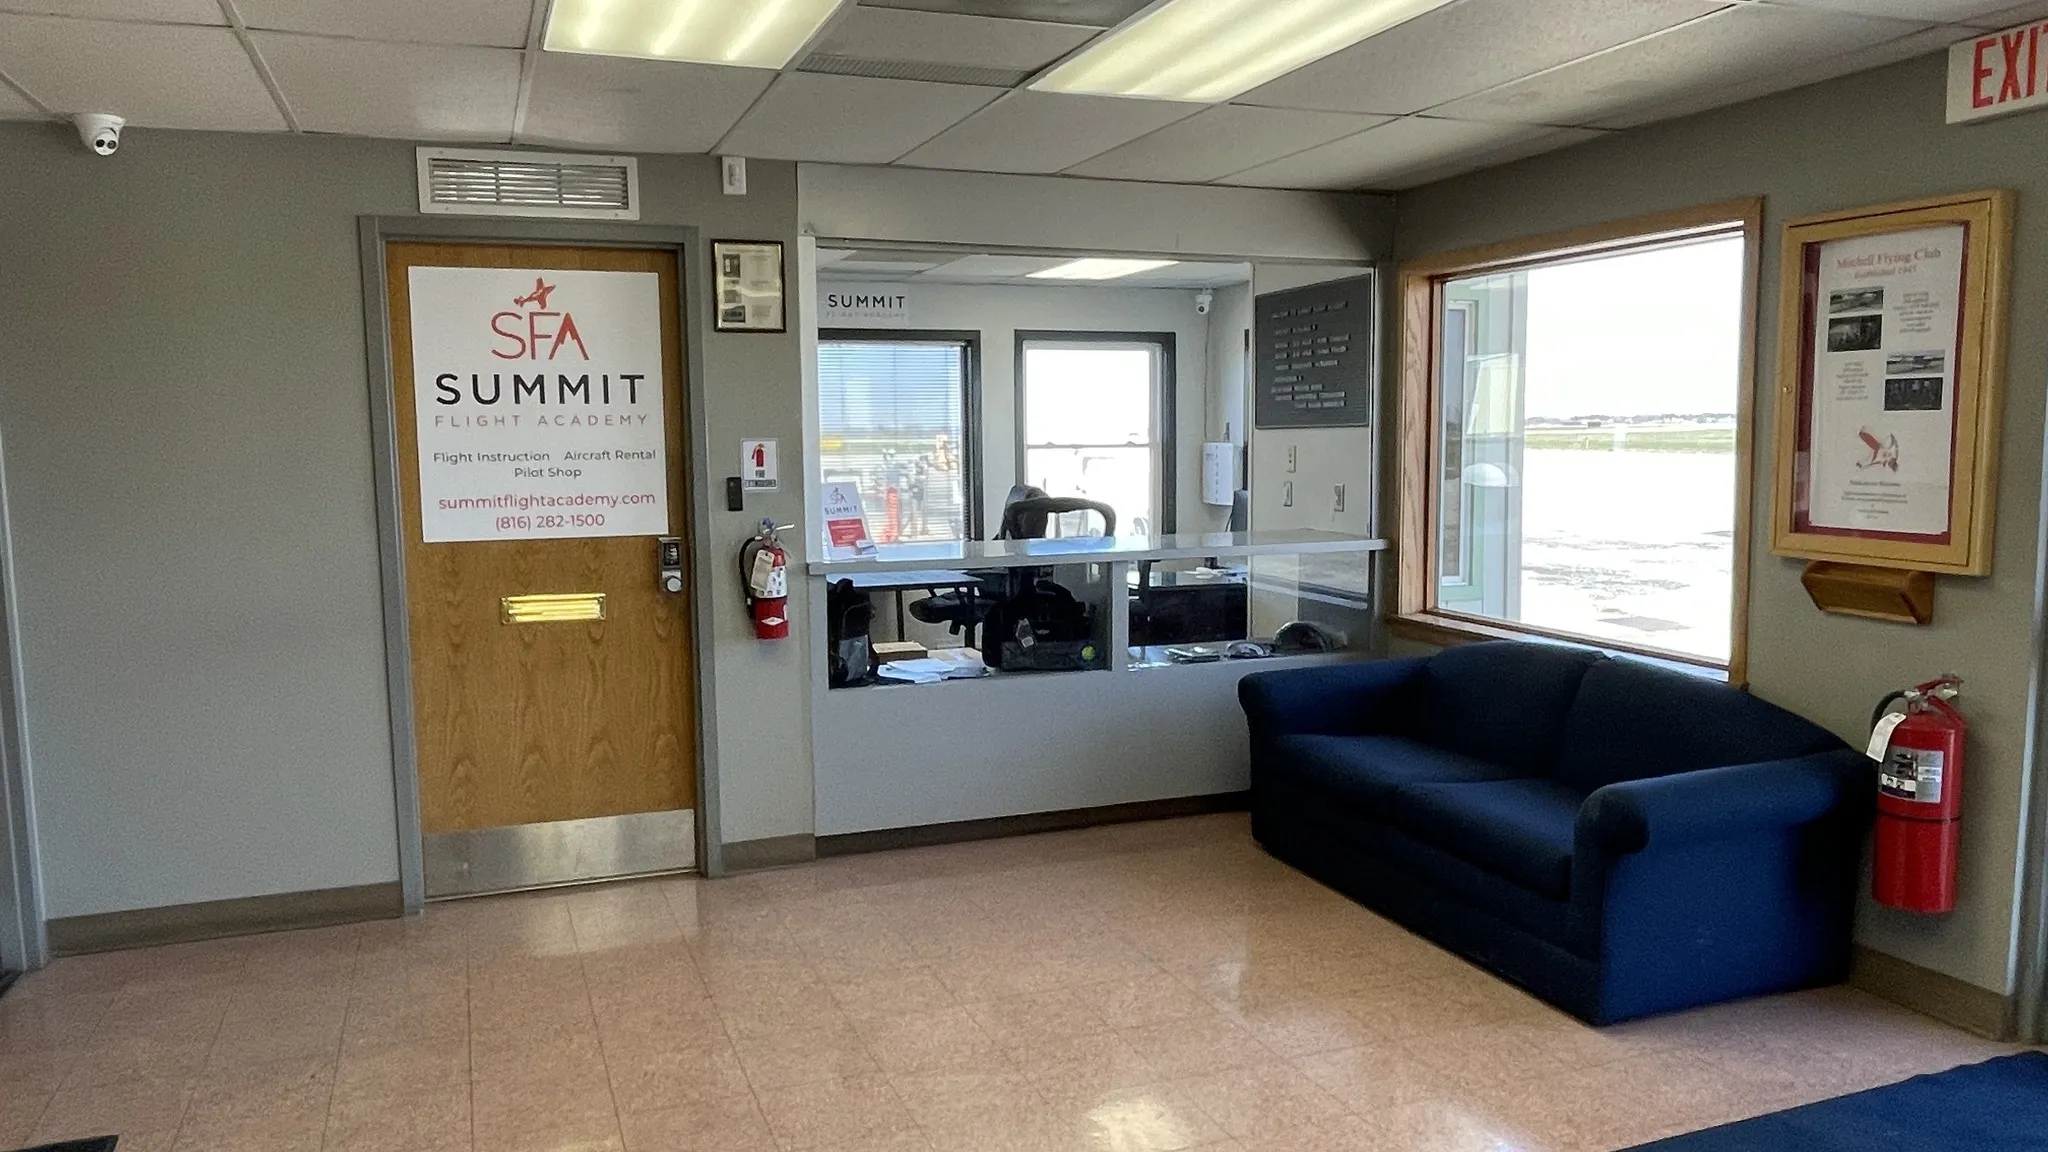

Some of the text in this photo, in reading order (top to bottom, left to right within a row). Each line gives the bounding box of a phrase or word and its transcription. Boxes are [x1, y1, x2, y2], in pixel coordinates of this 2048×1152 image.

[1971, 22, 2048, 109] EXI
[1914, 247, 1942, 261] Club
[827, 294, 906, 309] SUMMIT
[490, 311, 590, 361] SFA
[435, 373, 645, 405] SUMMIT
[434, 413, 650, 428] FLIGHT ACADEMY
[433, 449, 657, 466] Flight Instruction Aircraft Rental
[514, 467, 582, 480] Pilot Shop
[438, 492, 656, 511] summitflightacademy.com
[824, 505, 858, 516] SUMMIT
[495, 513, 606, 532] (816) 282-1500
